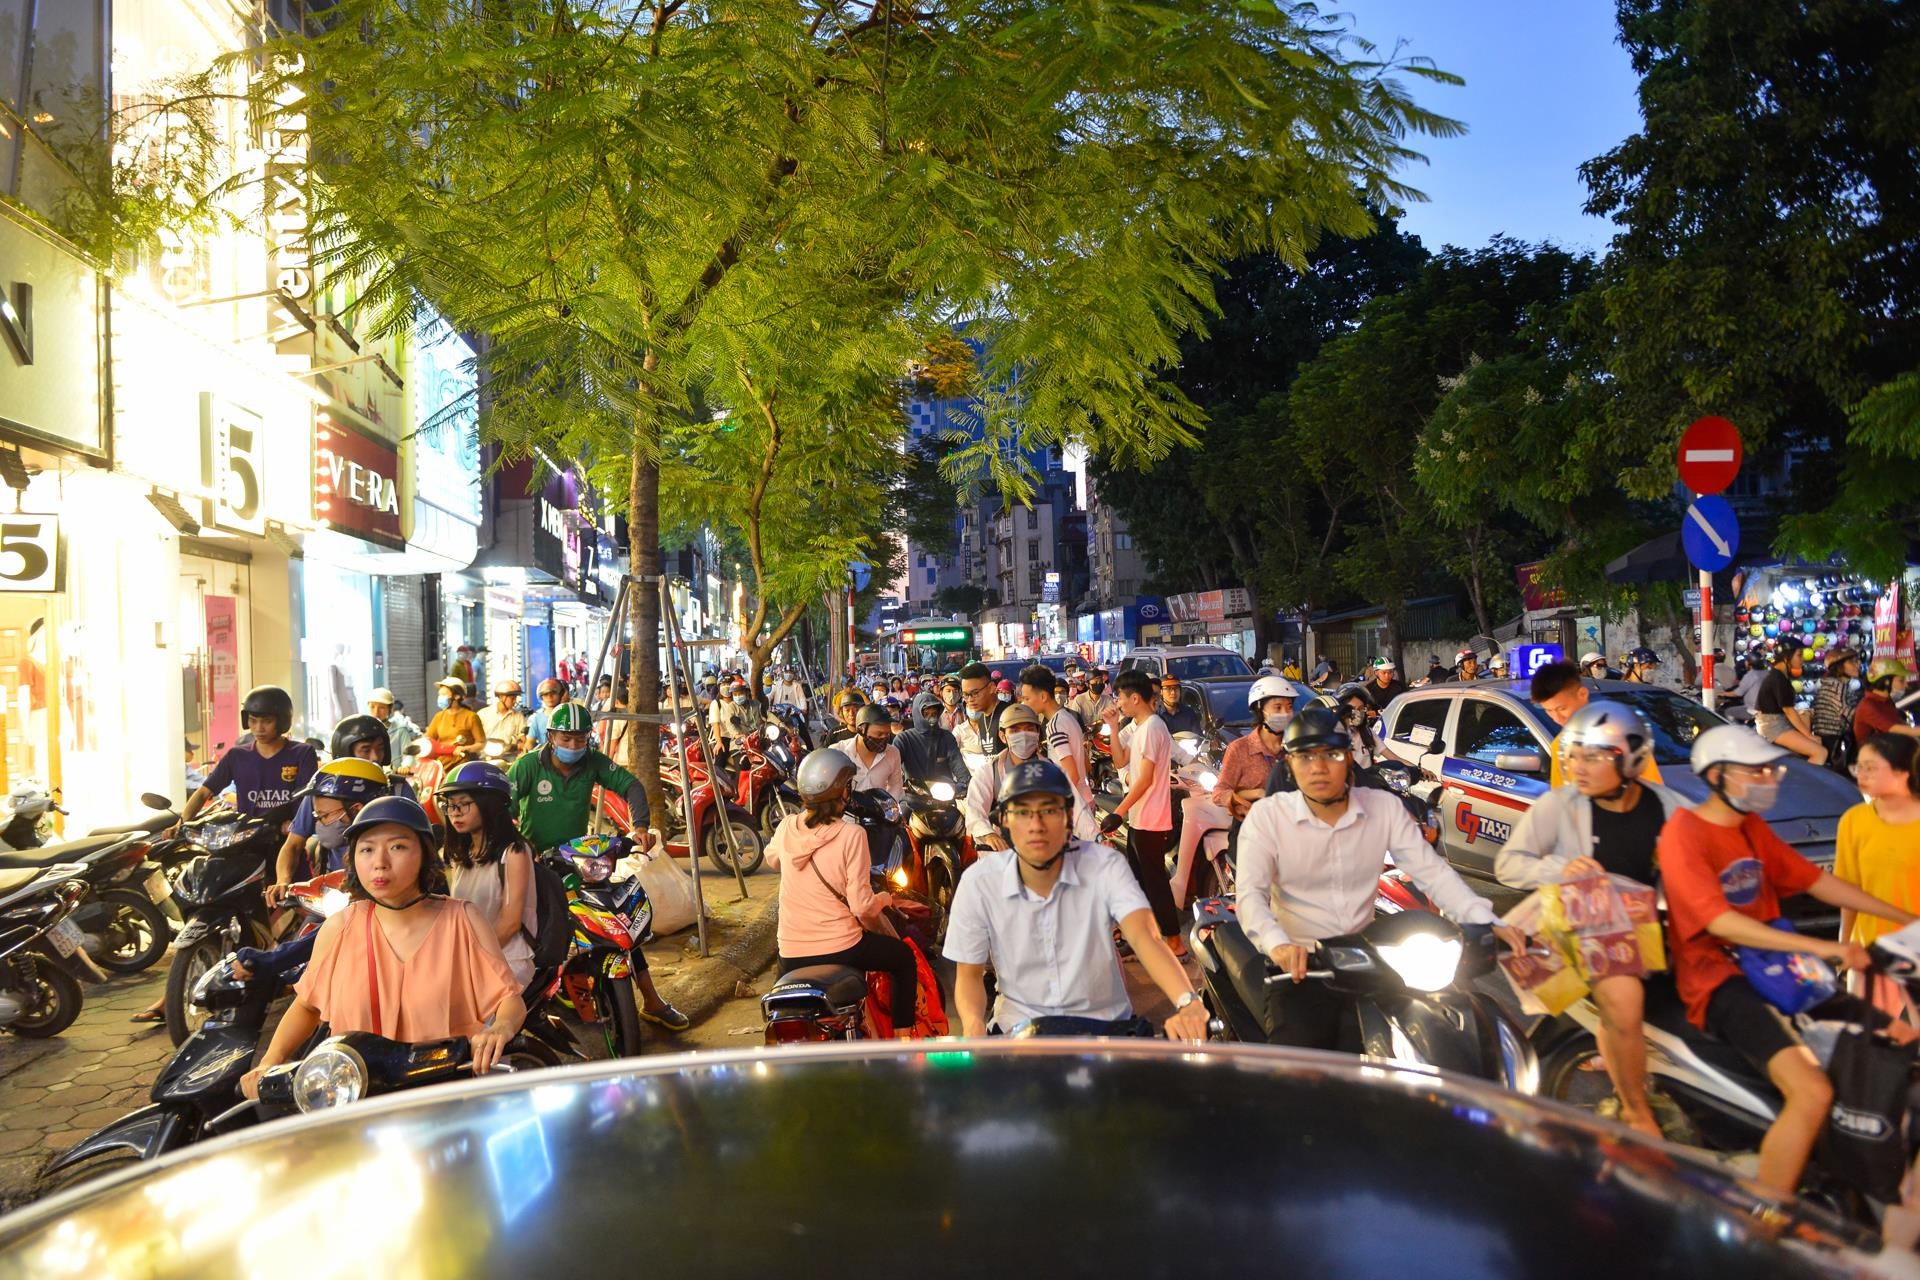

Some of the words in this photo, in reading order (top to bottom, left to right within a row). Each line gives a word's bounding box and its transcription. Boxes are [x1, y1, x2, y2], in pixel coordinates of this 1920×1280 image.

[327, 450, 399, 515] VERA
[0, 524, 49, 581] 5
[247, 789, 291, 803] QATAR
[1480, 817, 1511, 841] TAXI
[633, 908, 649, 932] YAMAHA
[781, 983, 812, 991] HONDA
